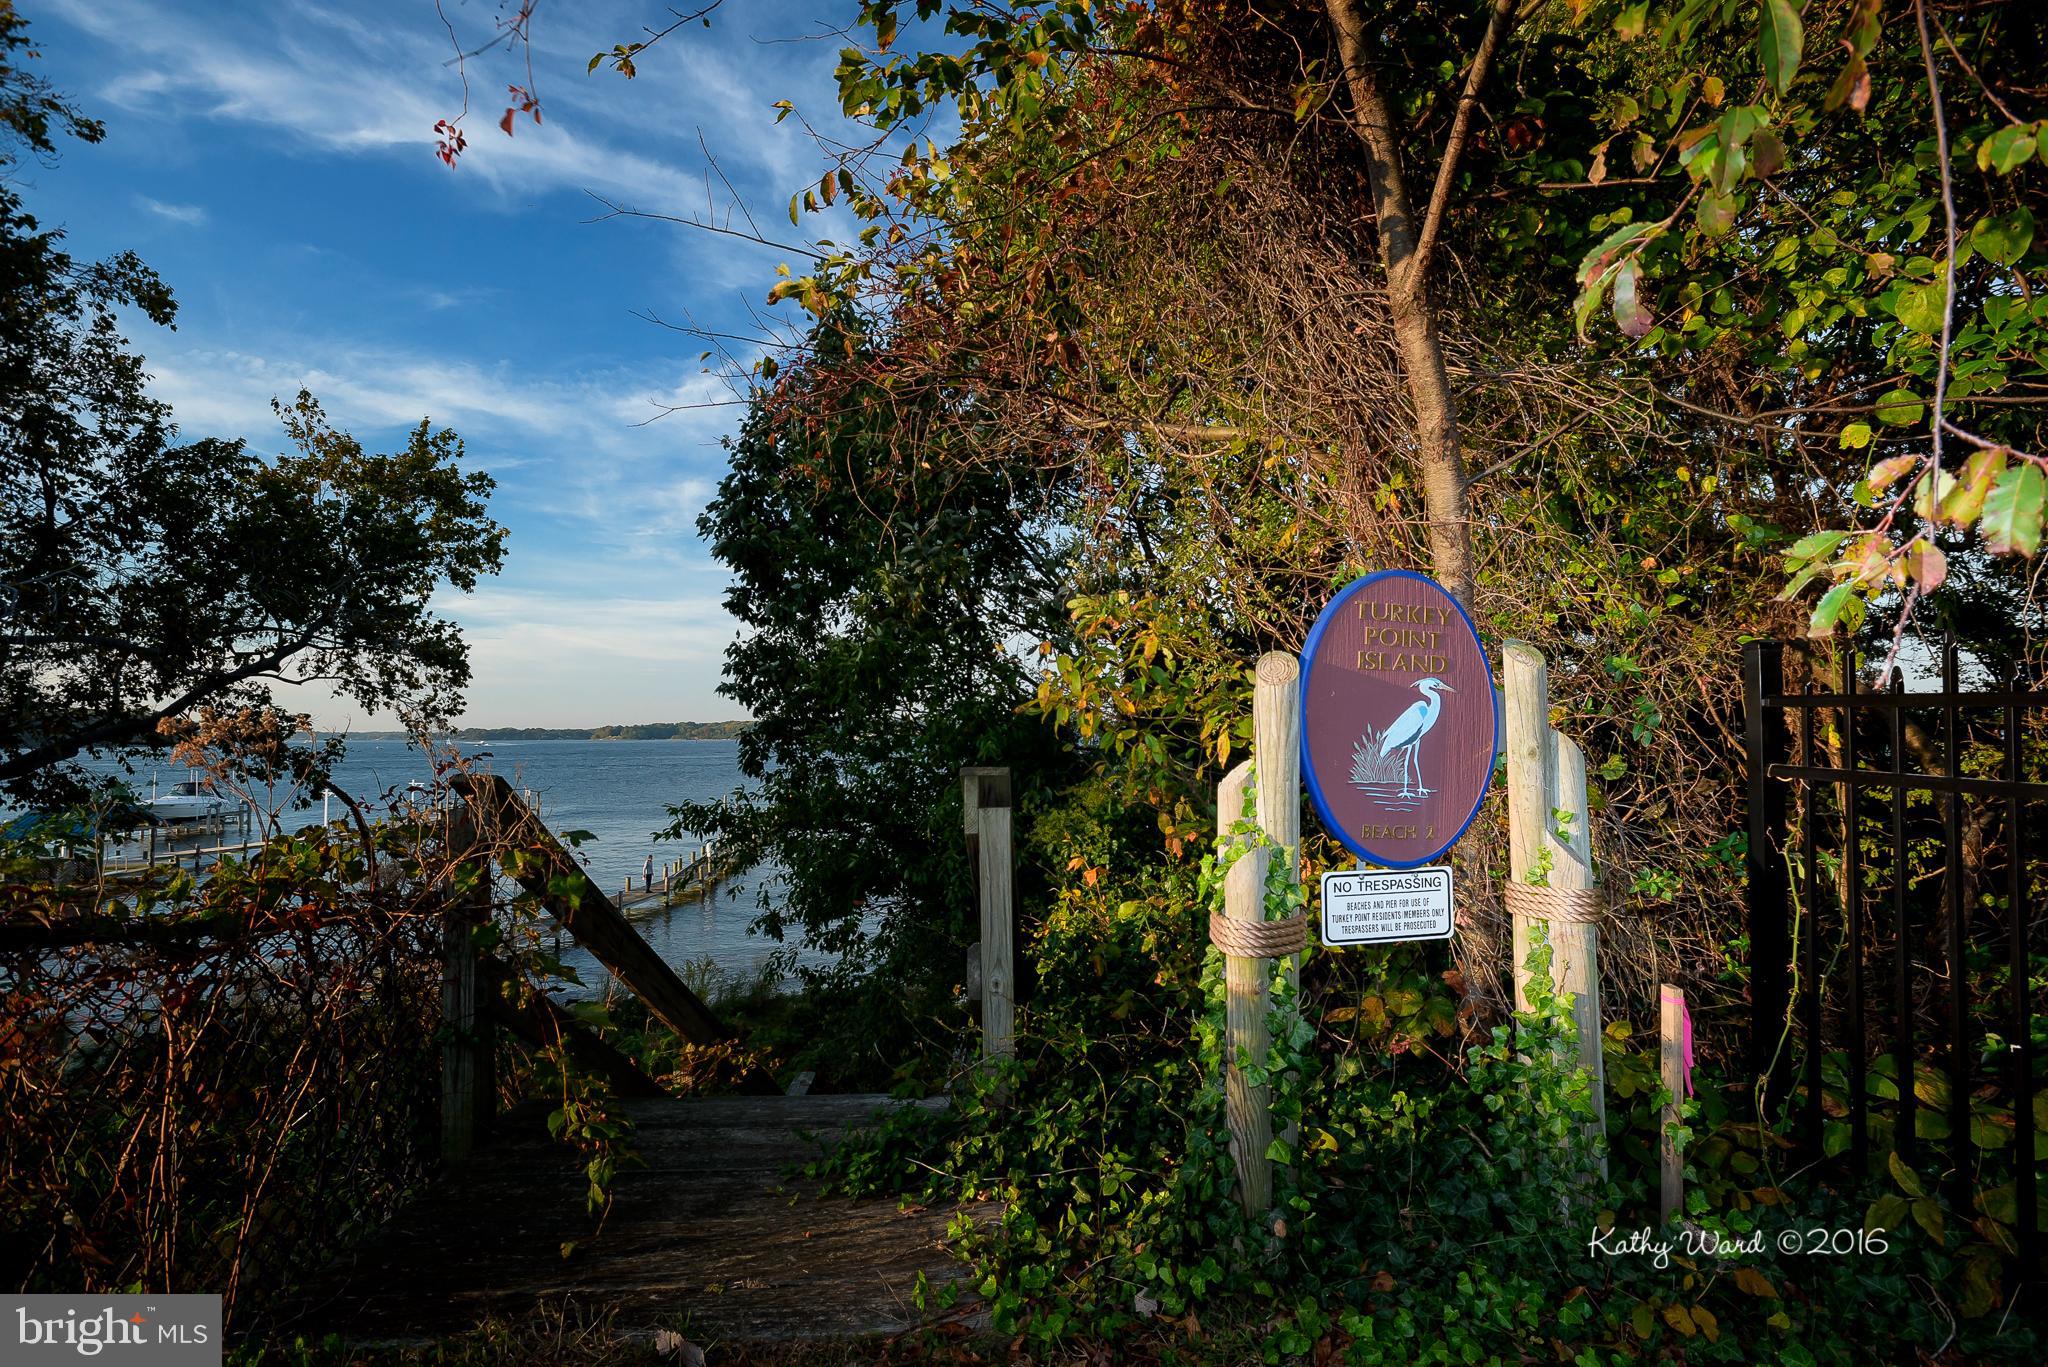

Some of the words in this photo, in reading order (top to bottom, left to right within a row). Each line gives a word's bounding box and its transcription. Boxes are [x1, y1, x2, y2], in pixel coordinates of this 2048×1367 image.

[1354, 600, 1452, 626] TURKEY
[1363, 627, 1442, 649] POINT
[1356, 650, 1449, 673] ISLAND
[1361, 824, 1417, 840] BEACH
[1425, 824, 1435, 839] 2
[1333, 882, 1352, 893] NO
[1357, 876, 1442, 892] TRESPASSING
[1347, 901, 1371, 911] BEACHES
[1373, 900, 1384, 910] AND
[1386, 899, 1397, 909] PIER
[1399, 899, 1409, 908] FOR
[1411, 898, 1421, 907] USE
[1423, 897, 1430, 906] OF
[1332, 913, 1353, 924] TURKEY
[1354, 912, 1370, 922] POINT
[1372, 910, 1401, 921] RESIDENTS
[1403, 909, 1430, 919] MEMBERS
[1431, 908, 1445, 917] ONLY
[1341, 923, 1379, 935] TRESPASSERS
[1381, 923, 1394, 932] WILL
[1395, 922, 1402, 931] BE
[1403, 920, 1437, 931] PROSECUTED
